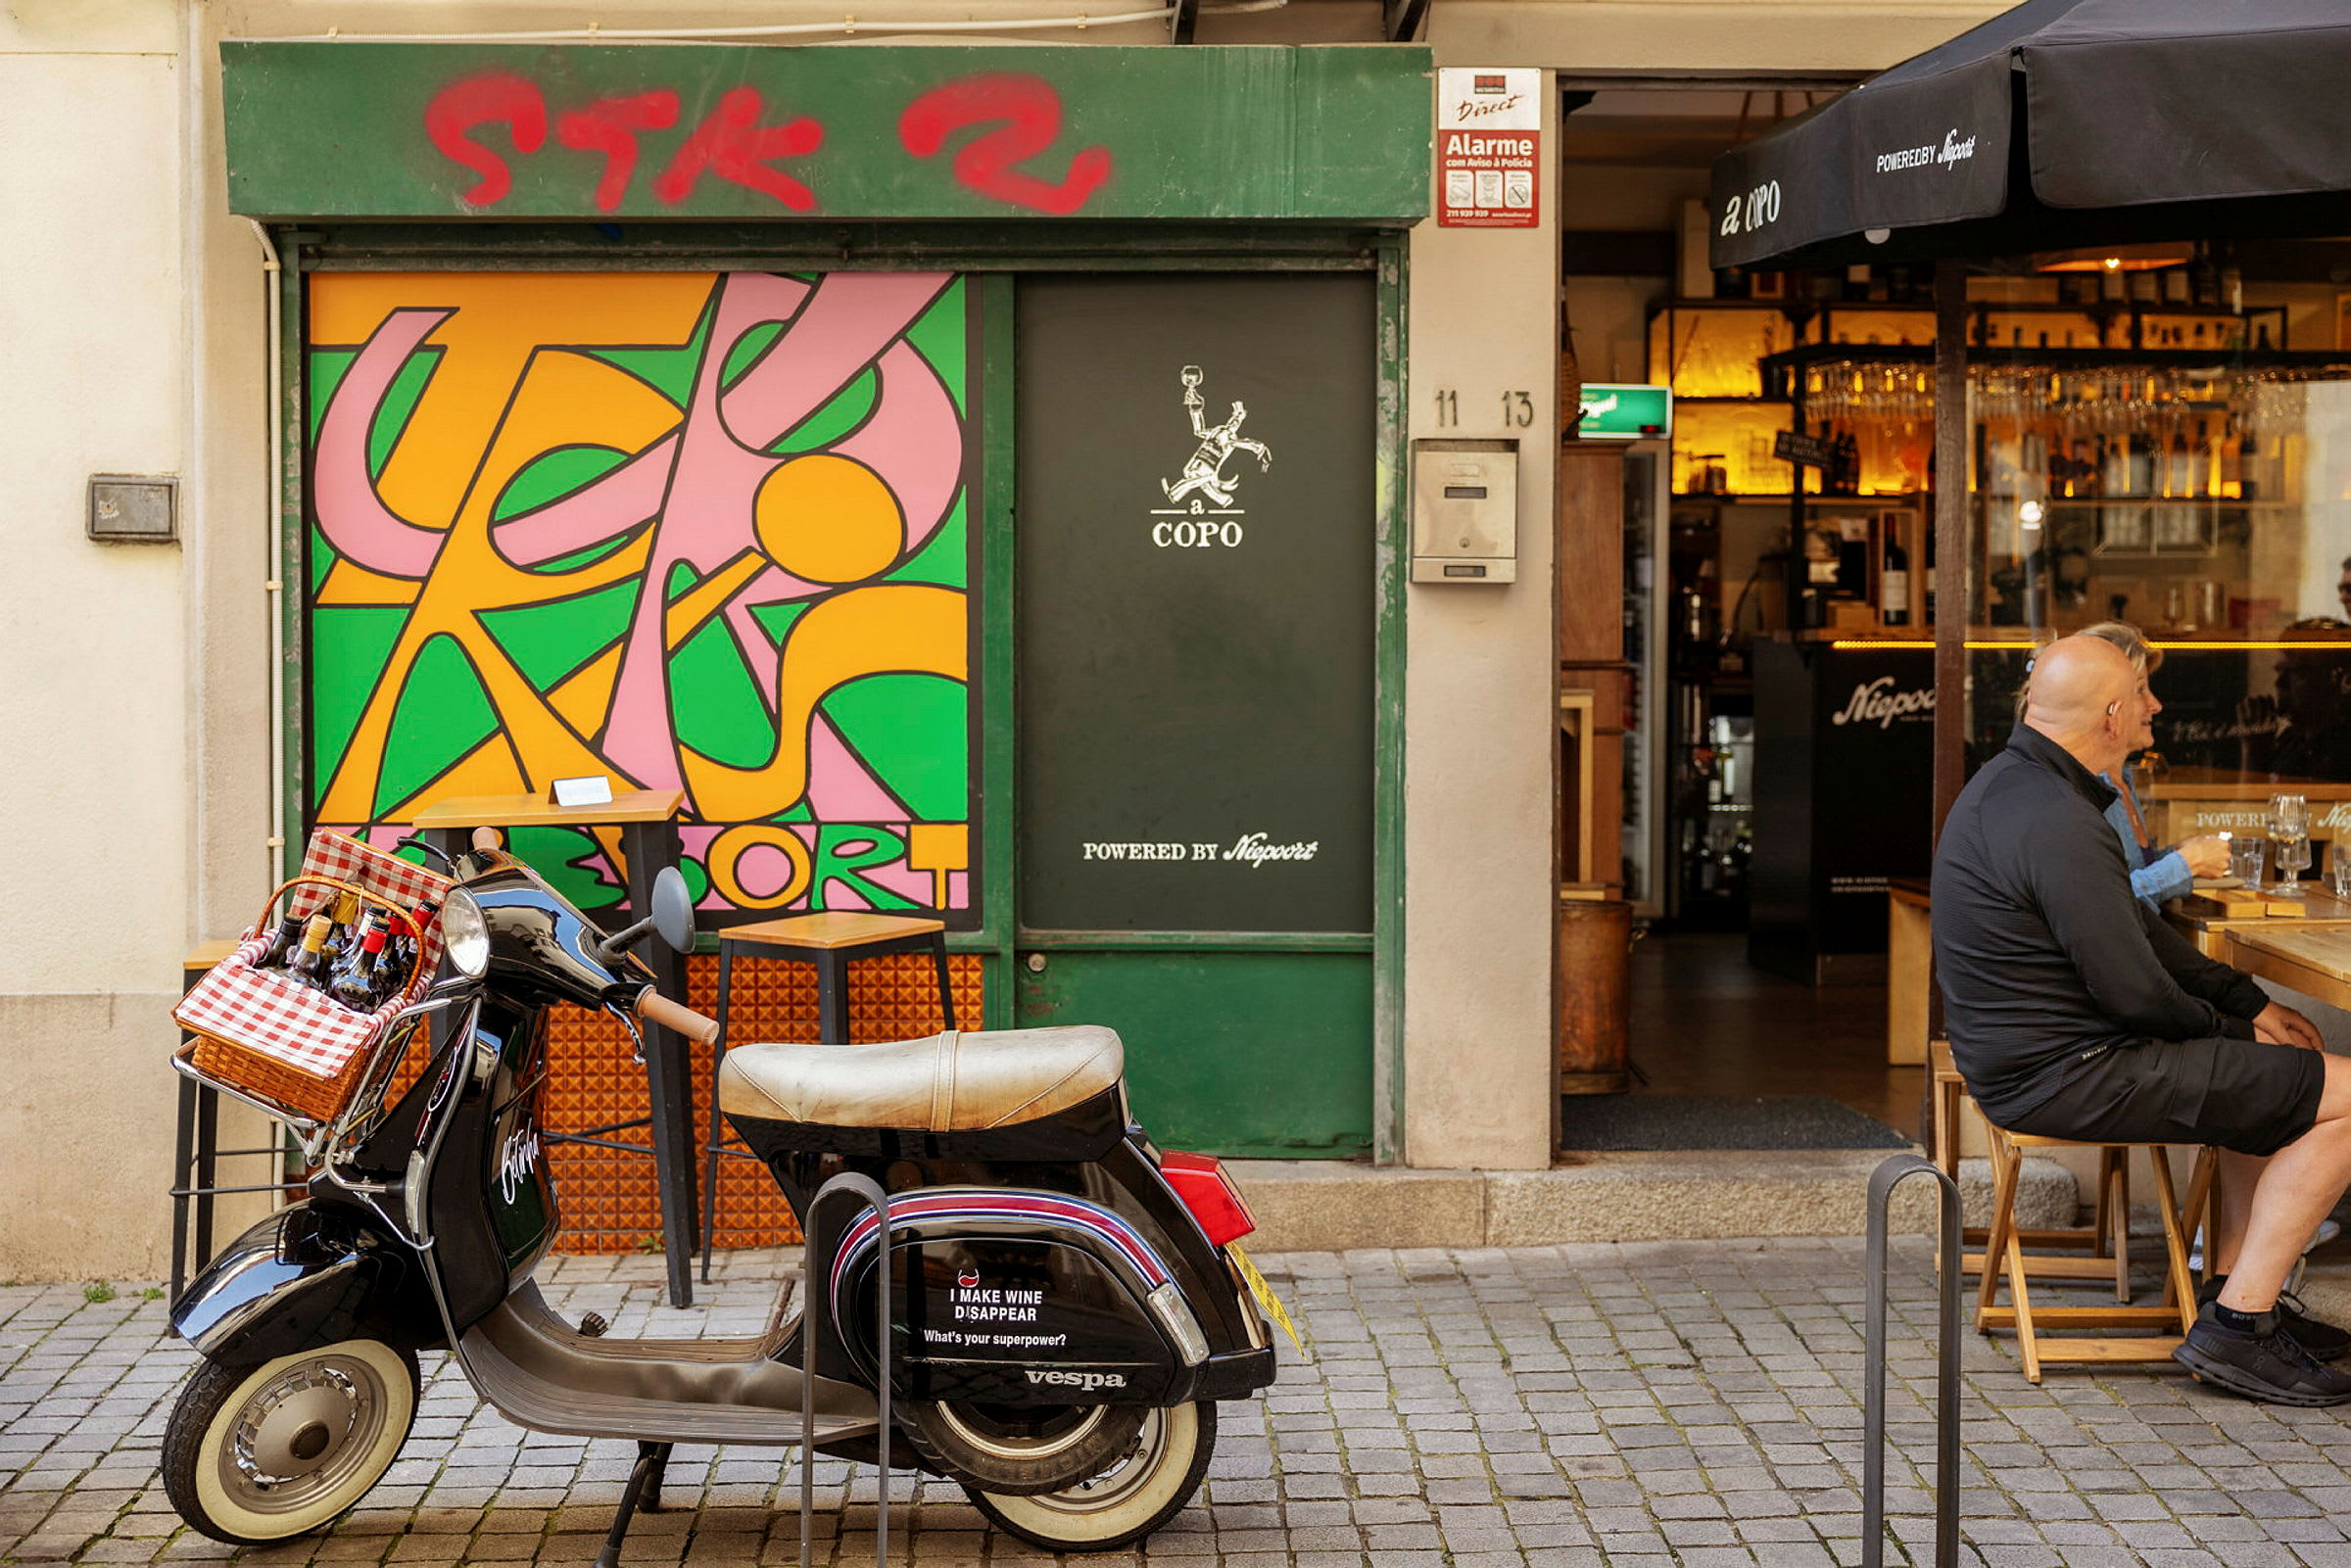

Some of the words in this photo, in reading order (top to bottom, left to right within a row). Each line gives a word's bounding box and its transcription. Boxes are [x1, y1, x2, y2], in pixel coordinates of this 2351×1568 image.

[1458, 94, 1525, 121] Direct
[1446, 133, 1534, 157] Alarme
[1446, 159, 1466, 167] com
[1466, 157, 1492, 167] Aviso
[1721, 195, 1742, 236] a
[1435, 390, 1458, 427] 11
[1502, 391, 1533, 427] 13
[1190, 499, 1205, 515] a
[1152, 520, 1243, 547] COPO
[1832, 676, 1937, 729] Niepoo
[1082, 842, 1186, 860] POWERED
[1190, 842, 1219, 860] BY
[1223, 832, 1319, 869] Niepoort
[950, 1288, 955, 1303] I
[959, 1289, 1001, 1304] MAKE
[1005, 1290, 1043, 1305] WINE
[924, 1329, 962, 1344] What's
[964, 1333, 991, 1347] your
[992, 1333, 1067, 1348] superpower?
[1025, 1370, 1127, 1391] vespa
